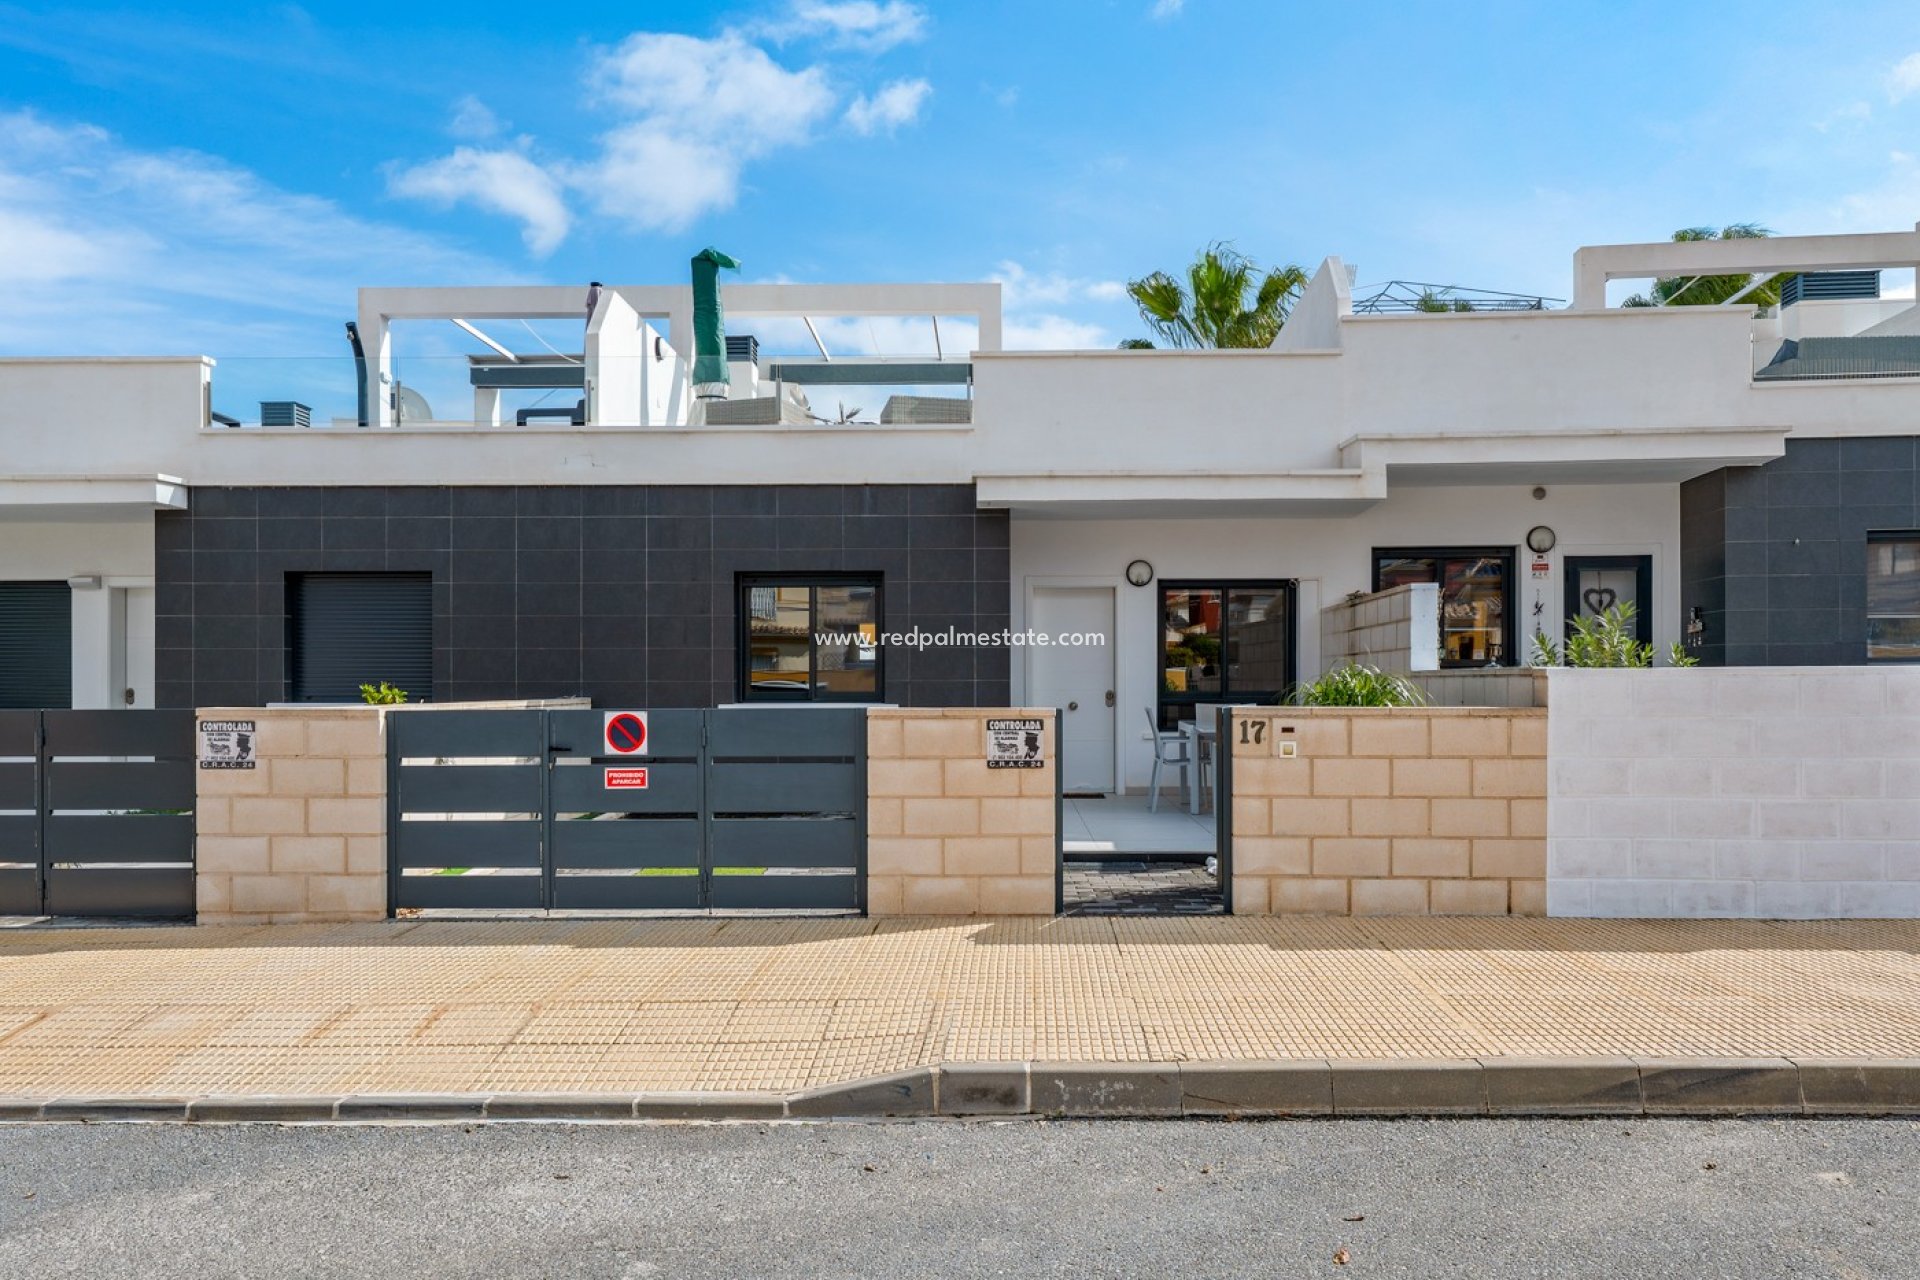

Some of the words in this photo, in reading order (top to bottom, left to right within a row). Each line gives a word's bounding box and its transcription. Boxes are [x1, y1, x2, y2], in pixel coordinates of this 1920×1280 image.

[202, 722, 253, 731] CONTROLADA
[989, 720, 1041, 730] CONTROLADA
[1240, 719, 1267, 745] 17
